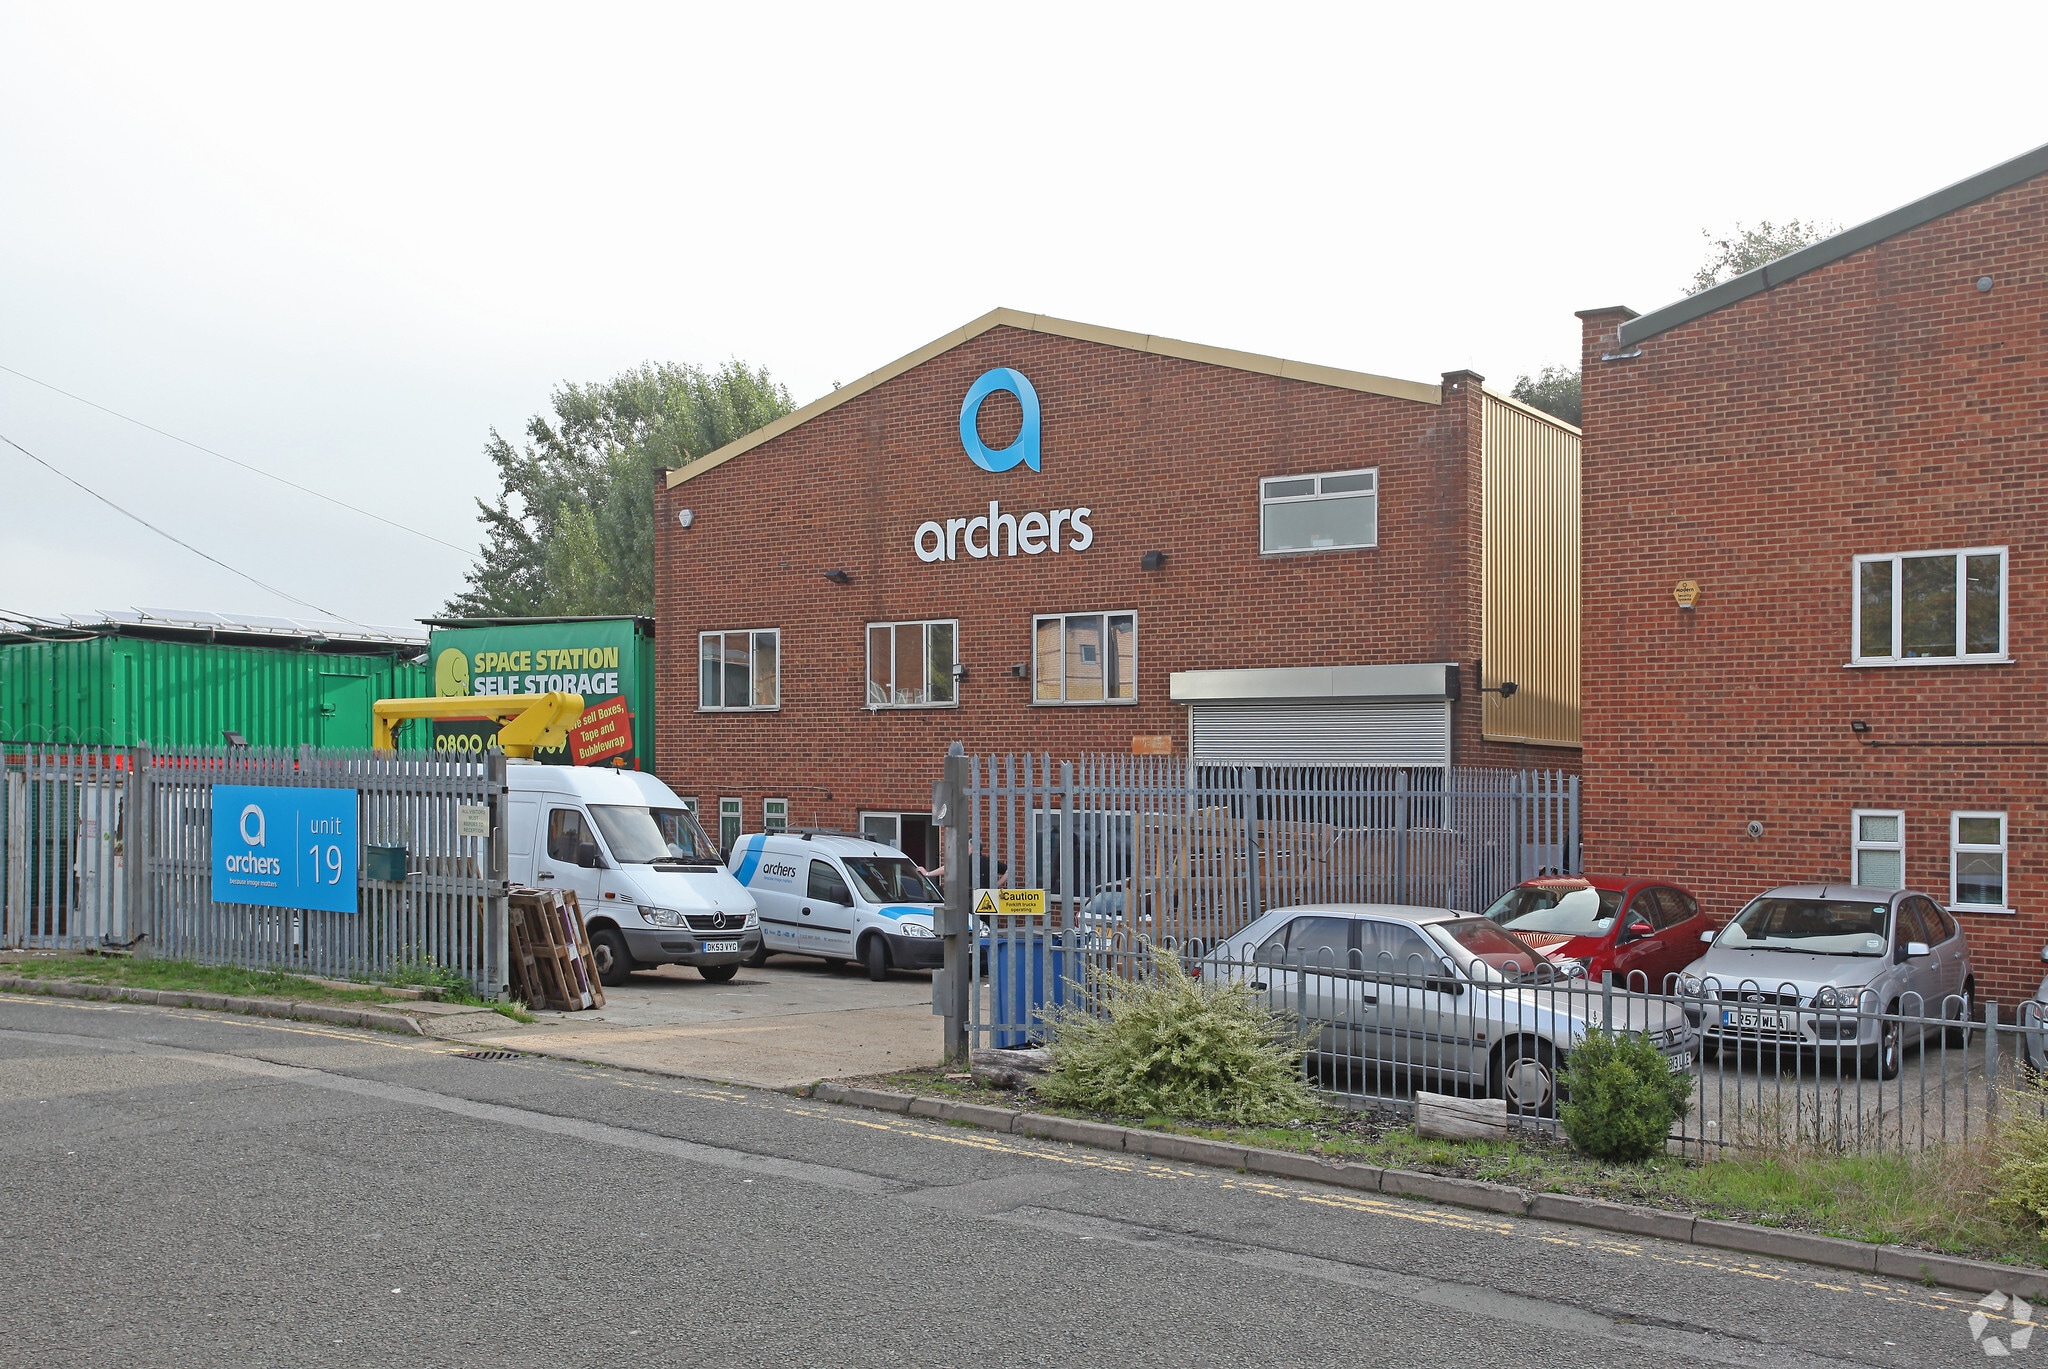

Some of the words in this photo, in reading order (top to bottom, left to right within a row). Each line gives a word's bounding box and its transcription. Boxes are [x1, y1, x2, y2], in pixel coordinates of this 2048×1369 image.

[914, 500, 1094, 563] archers
[474, 651, 531, 673] SPACE
[536, 647, 619, 671] STATION
[474, 676, 519, 696] SELF
[525, 672, 619, 695] STORAGE
[583, 711, 597, 726] sell
[597, 703, 625, 720] Boxes,
[580, 728, 599, 742] Tape
[600, 720, 615, 735] and
[436, 734, 483, 754] 0800
[578, 735, 625, 760] Bubblewrap
[310, 816, 342, 835] unit
[225, 850, 281, 876] archers
[309, 844, 343, 885] 19
[763, 862, 797, 878] archers
[1003, 892, 1039, 901] Caution
[724, 943, 737, 951] VYG
[1762, 1016, 1784, 1029] WLA
